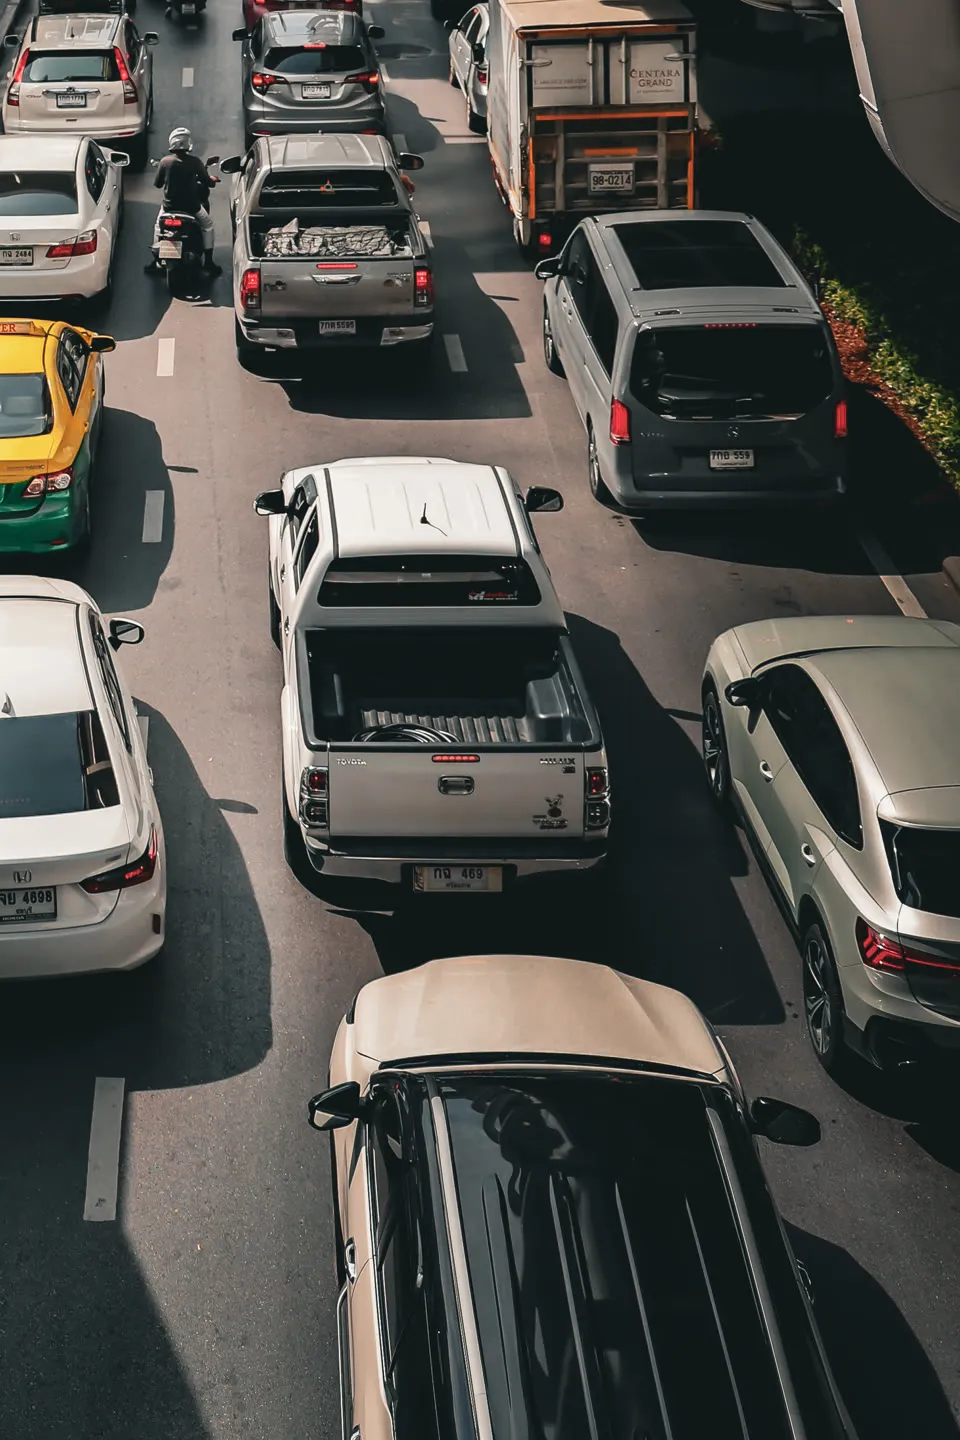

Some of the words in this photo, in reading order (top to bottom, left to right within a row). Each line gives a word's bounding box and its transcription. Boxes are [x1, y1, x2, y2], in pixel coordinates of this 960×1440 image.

[629, 67, 681, 79] CENTARA
[638, 78, 673, 87] GRAND
[592, 175, 631, 186] 98-0214
[15, 250, 32, 258] 2484
[733, 451, 750, 460] 559
[336, 758, 367, 766] TOYOTA
[461, 868, 483, 880] 469
[22, 890, 53, 904] 4698
